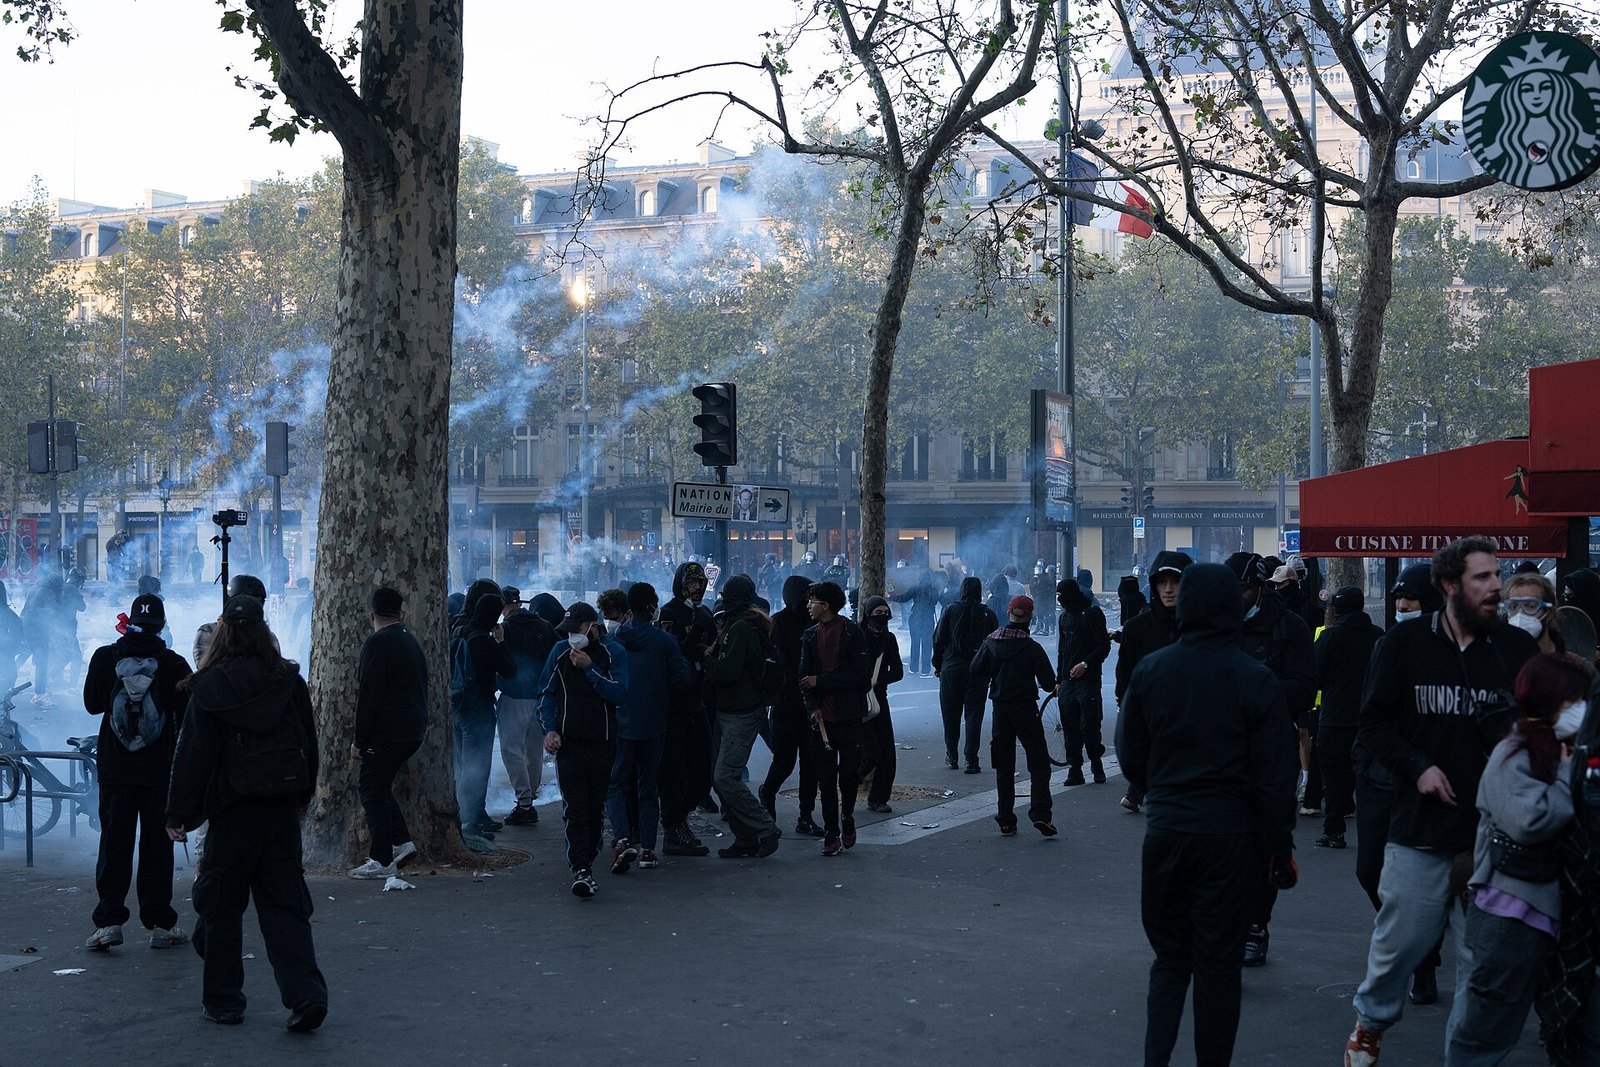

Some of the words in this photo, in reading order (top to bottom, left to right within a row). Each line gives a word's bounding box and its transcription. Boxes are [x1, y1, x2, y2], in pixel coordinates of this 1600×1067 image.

[680, 488, 731, 501] NATION
[680, 502, 712, 514] Mairie
[716, 504, 728, 514] du
[1136, 519, 1142, 527] P
[1335, 535, 1413, 550] CUISINE
[1421, 535, 1529, 551] ITANNE
